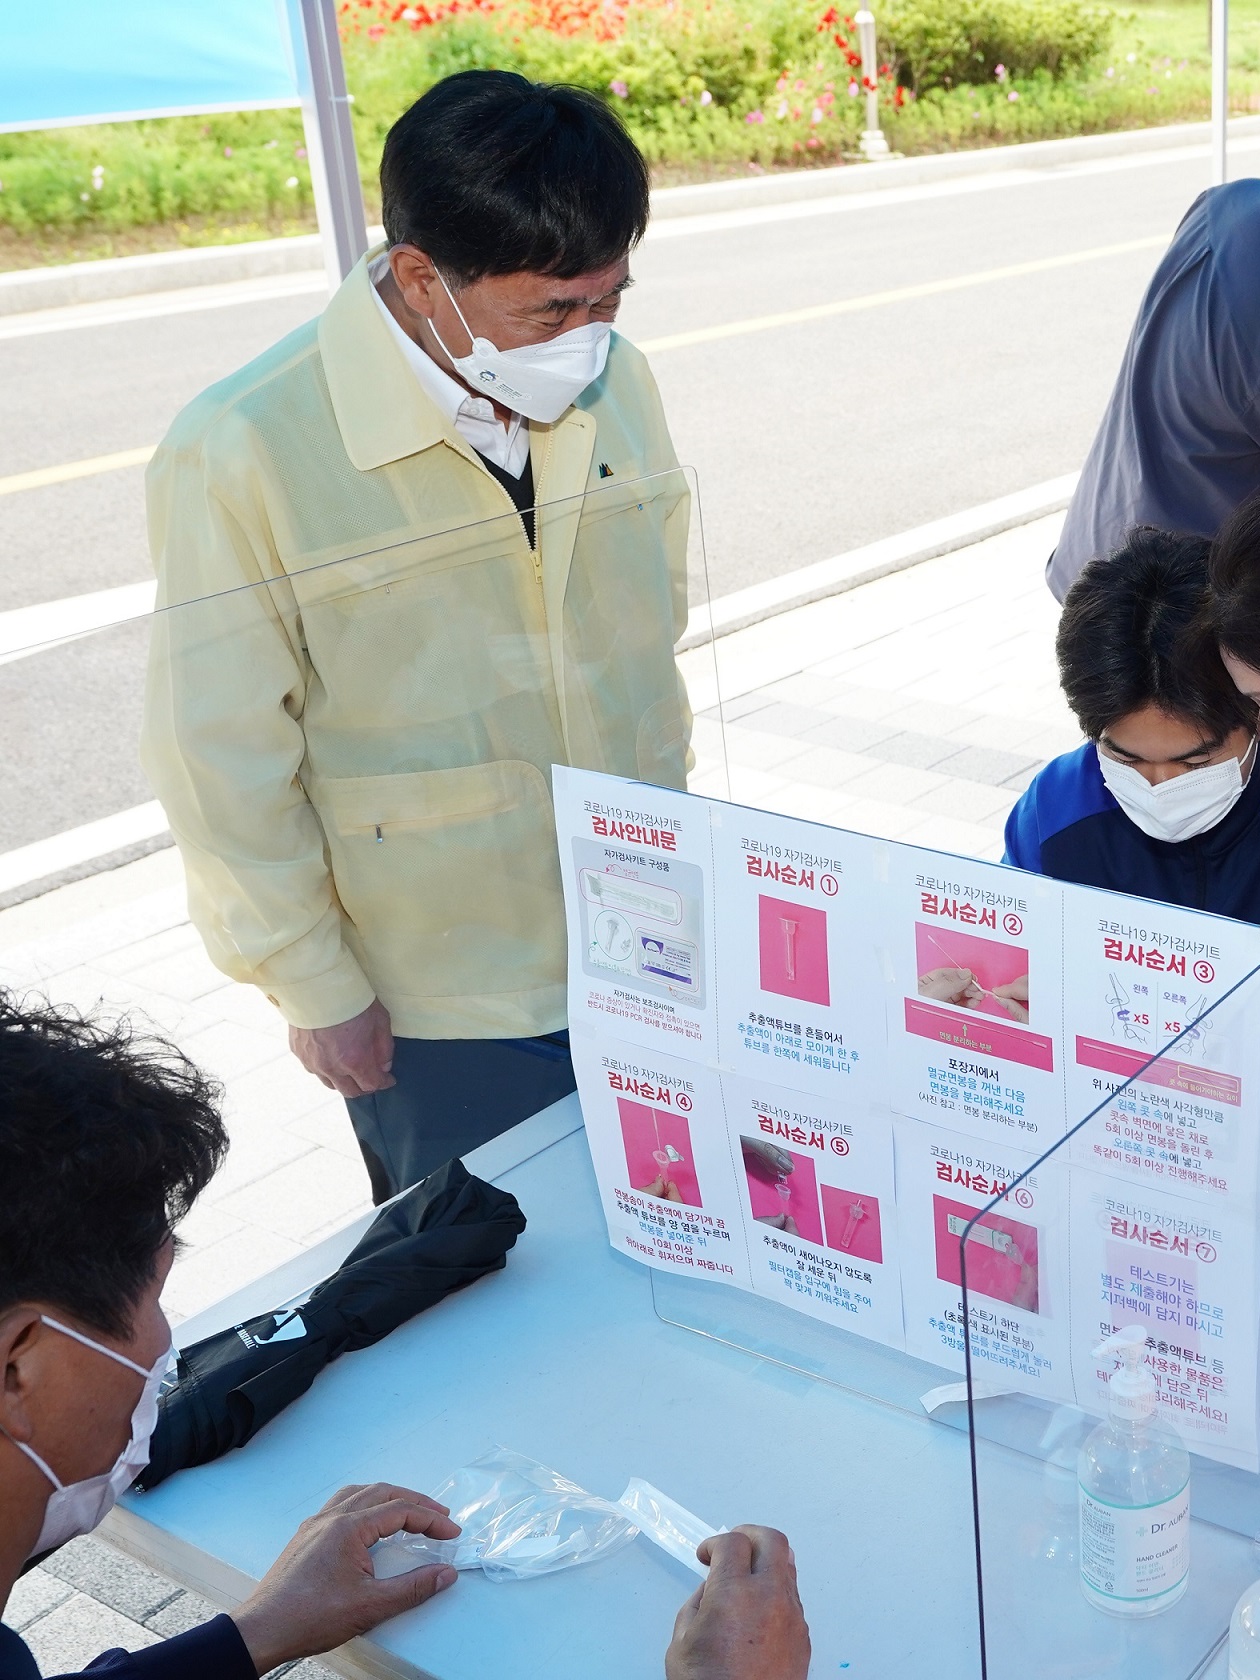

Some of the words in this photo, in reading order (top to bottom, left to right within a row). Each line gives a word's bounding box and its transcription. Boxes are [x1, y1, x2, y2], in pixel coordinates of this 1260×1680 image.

[584, 800, 622, 819] 코로나19
[625, 810, 682, 831] 자가검사키트
[592, 816, 676, 851] 검사안내문
[604, 849, 646, 865] 자가검사키트
[648, 859, 669, 872] 구성품
[741, 837, 781, 858] 코로나19
[784, 848, 842, 873] 자가검사키트
[747, 855, 814, 890] 검사순서
[915, 874, 960, 895] 코로나19
[963, 886, 1027, 912] 자가검사키트
[921, 892, 996, 929] 검사순서
[1098, 919, 1146, 941] 코로나19
[1150, 932, 1220, 959] 자가검사키트
[1104, 937, 1185, 976] 검사순서
[749, 1012, 801, 1035] 추출액튜브를
[805, 1026, 842, 1045] 흔들어서
[744, 1037, 769, 1054] 튜브를
[773, 1046, 800, 1062] 한쪽에
[803, 1054, 850, 1073] 세워둡니다
[949, 1058, 998, 1081] 포장지에서
[608, 1071, 670, 1105] 검사순서
[930, 1081, 959, 1099] 면봉을
[963, 1091, 1024, 1116] 분리해주세요
[758, 1114, 824, 1150] 검사순서
[1136, 1554, 1154, 1562] HAND
